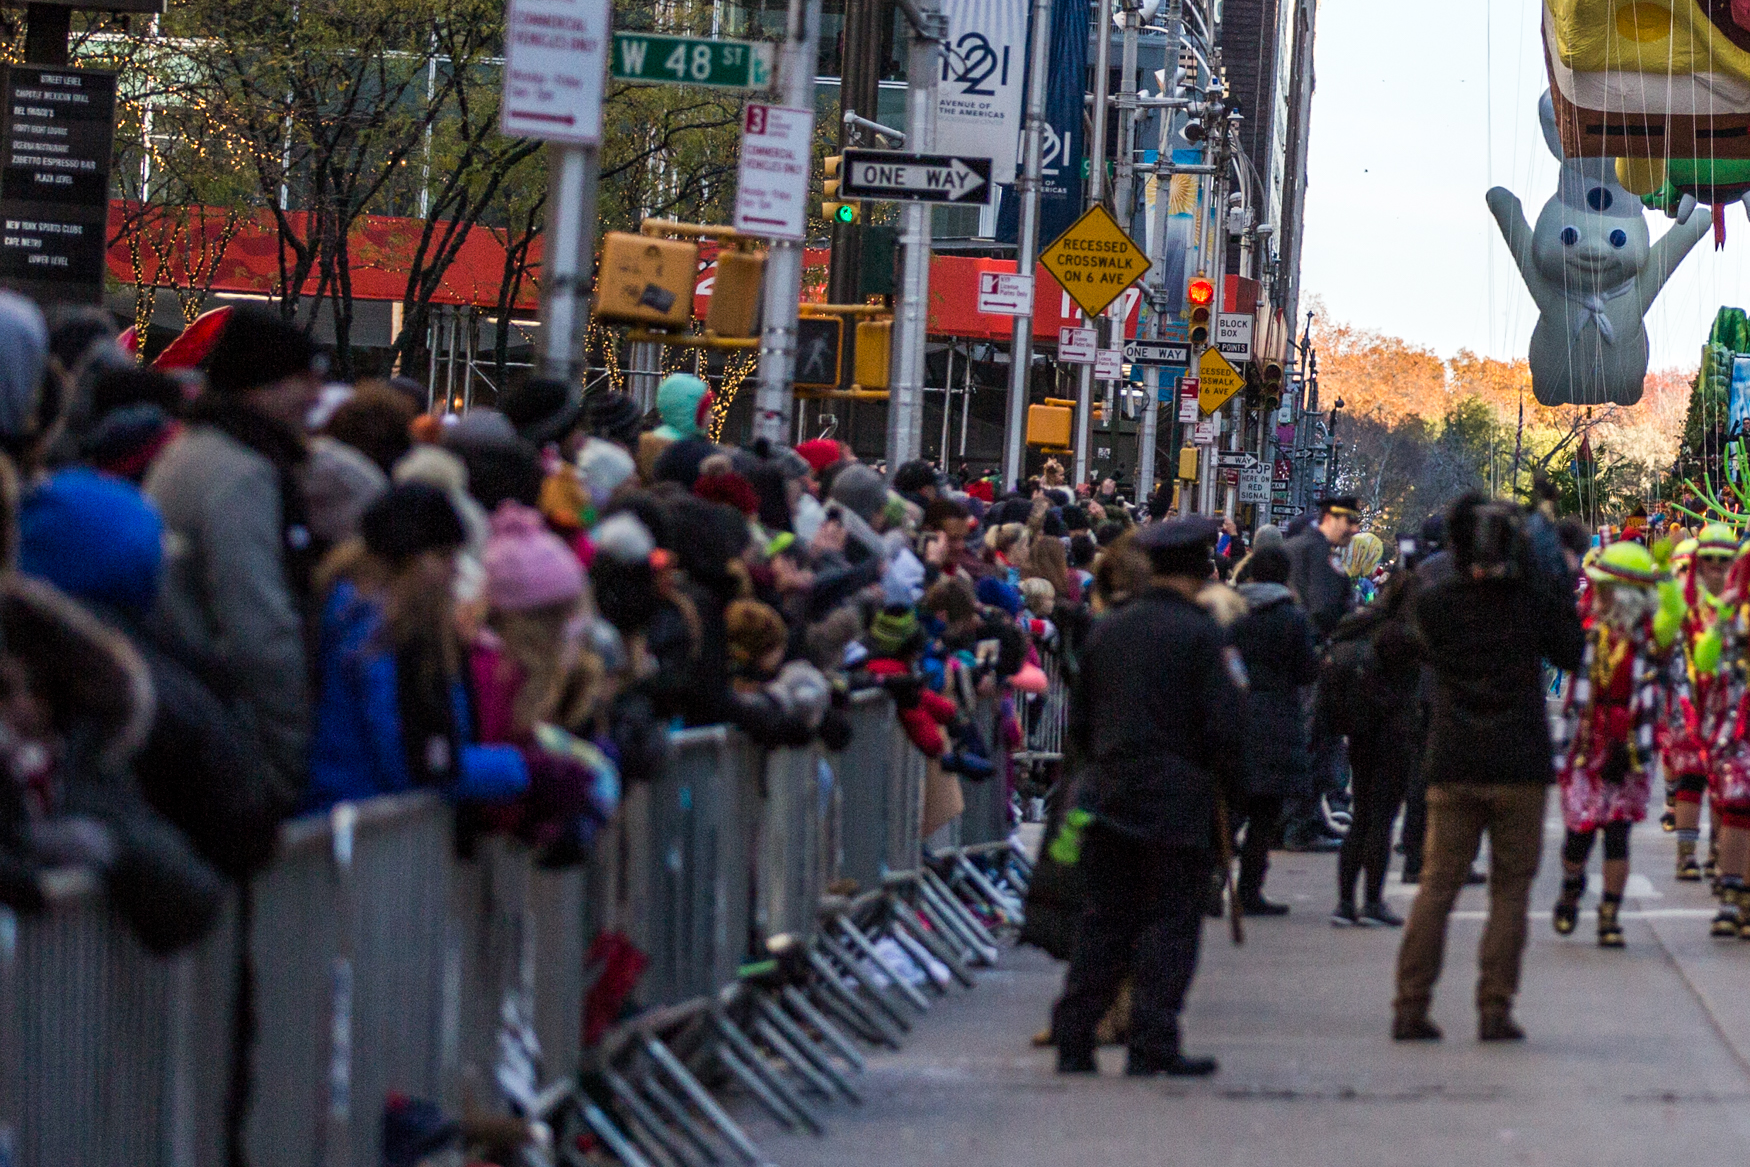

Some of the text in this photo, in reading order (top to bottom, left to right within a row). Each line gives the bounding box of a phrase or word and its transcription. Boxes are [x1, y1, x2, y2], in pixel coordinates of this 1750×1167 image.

[621, 41, 743, 81] W 48 ST
[939, 99, 976, 109] AVENUE
[938, 107, 1006, 119] THE AMERICAS
[42, 157, 80, 168] ESPRESSO
[863, 166, 971, 190] ONE WAY
[6, 220, 21, 230] NEW
[1063, 238, 1128, 254] RECESSED
[1057, 254, 1133, 270] CROSSWALK
[1064, 270, 1125, 285] ON 6 AVE
[1219, 319, 1248, 328] BLOCK
[1220, 329, 1238, 337] BOX
[1126, 346, 1182, 359] ONE WAY
[1221, 343, 1246, 352] POINTS
[1235, 456, 1253, 464] WAY
[1241, 475, 1259, 483] HERE
[1247, 483, 1263, 491] RED
[1241, 491, 1269, 500] SIGNAL
